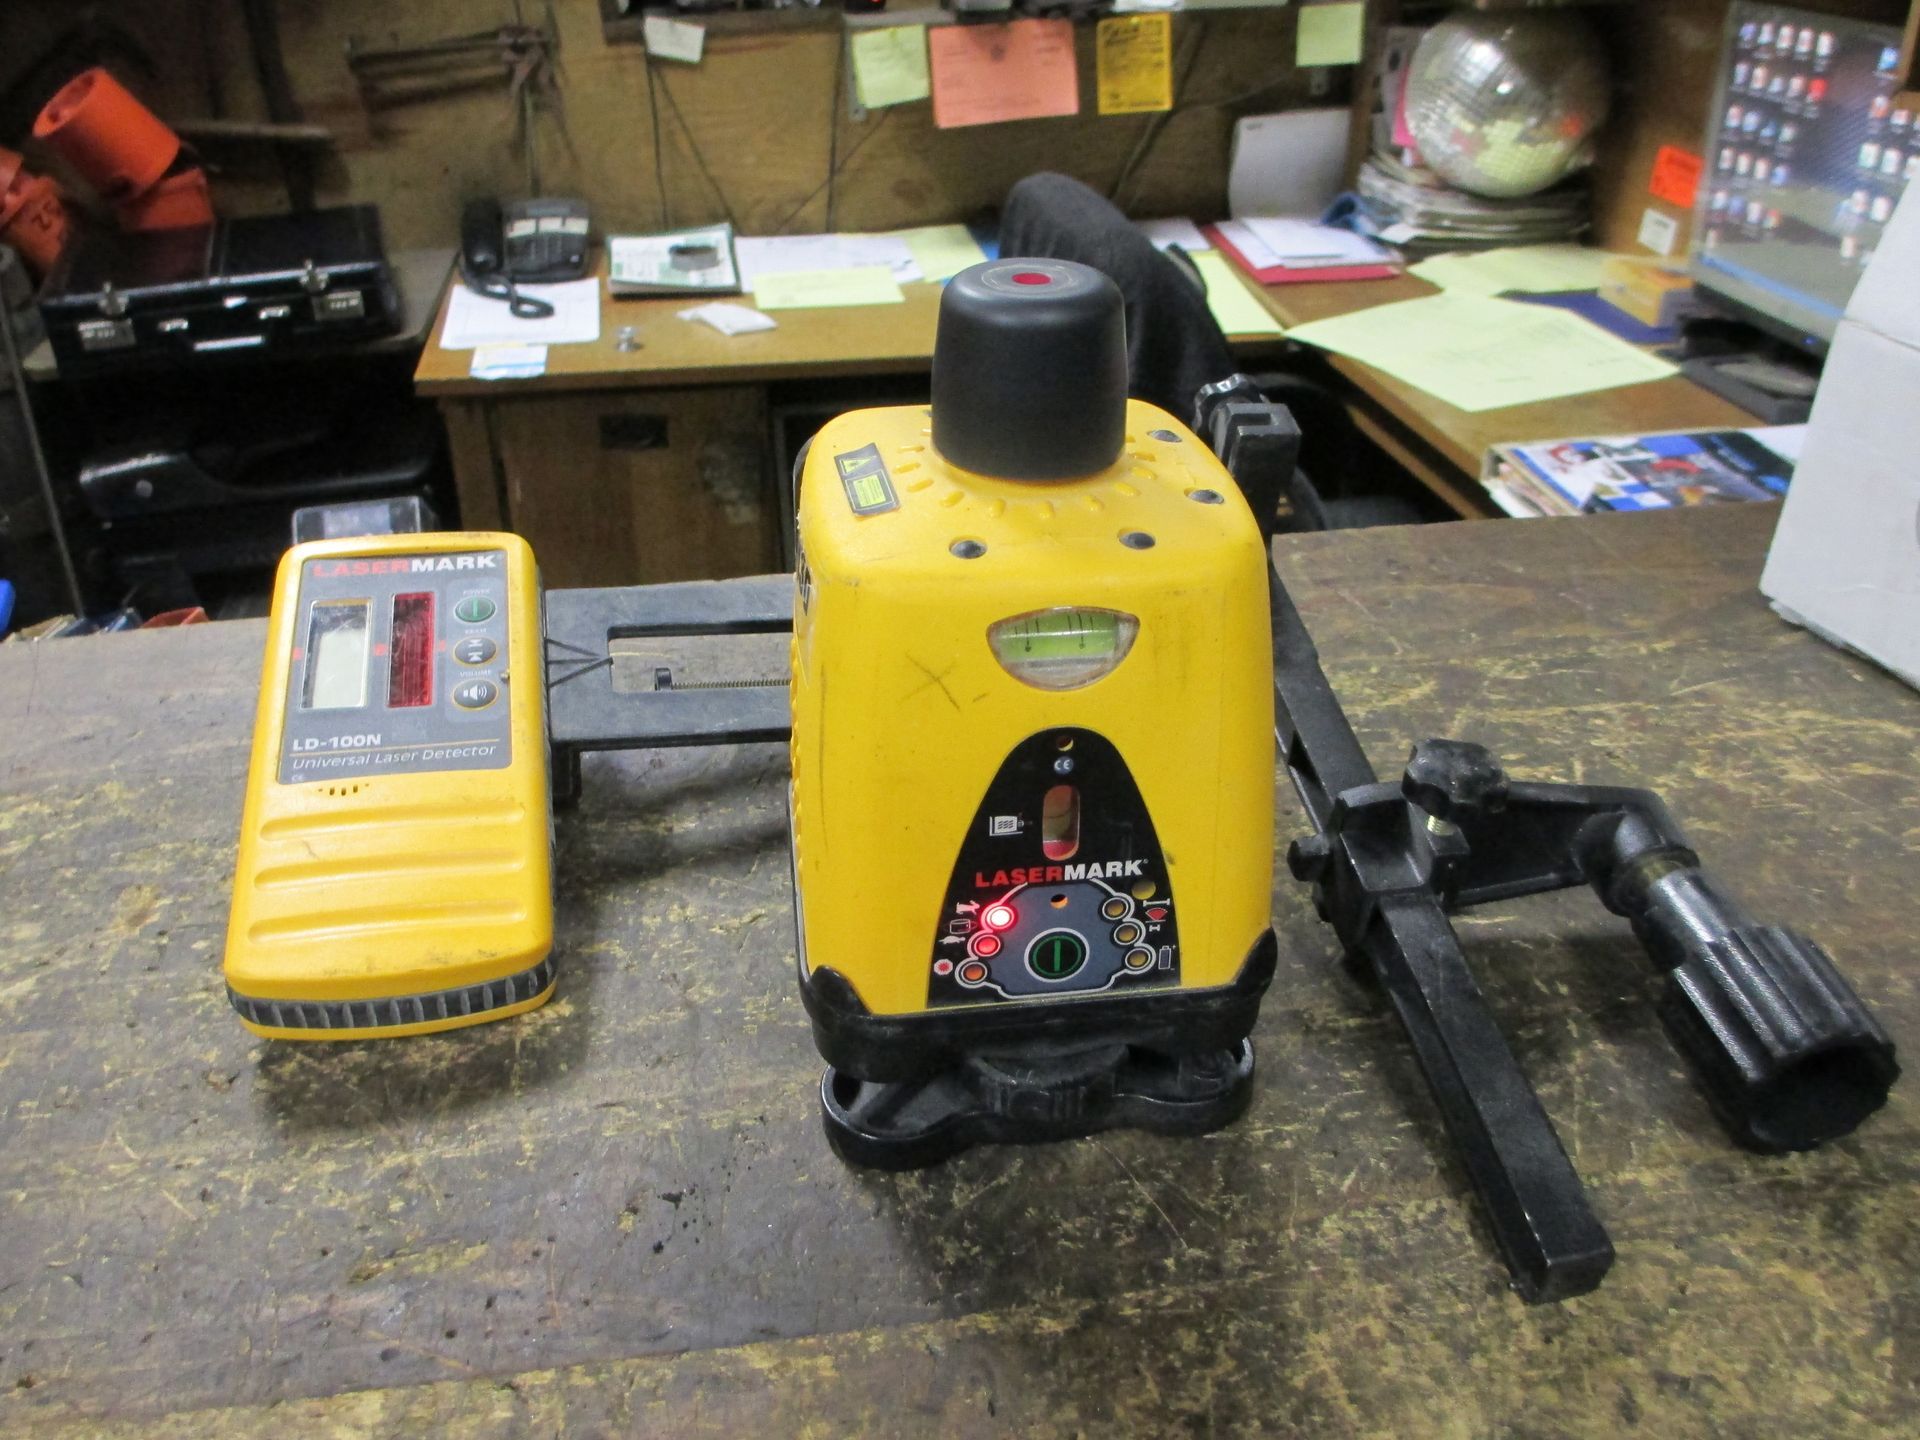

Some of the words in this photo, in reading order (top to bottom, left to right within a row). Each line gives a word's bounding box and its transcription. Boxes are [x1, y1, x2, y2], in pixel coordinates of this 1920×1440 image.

[313, 555, 496, 577] LASERMARK
[460, 669, 491, 678] VOLUME
[293, 734, 381, 751] LD-100N
[293, 752, 370, 769] Universal
[375, 751, 418, 764] Laser
[422, 745, 497, 760] Detector
